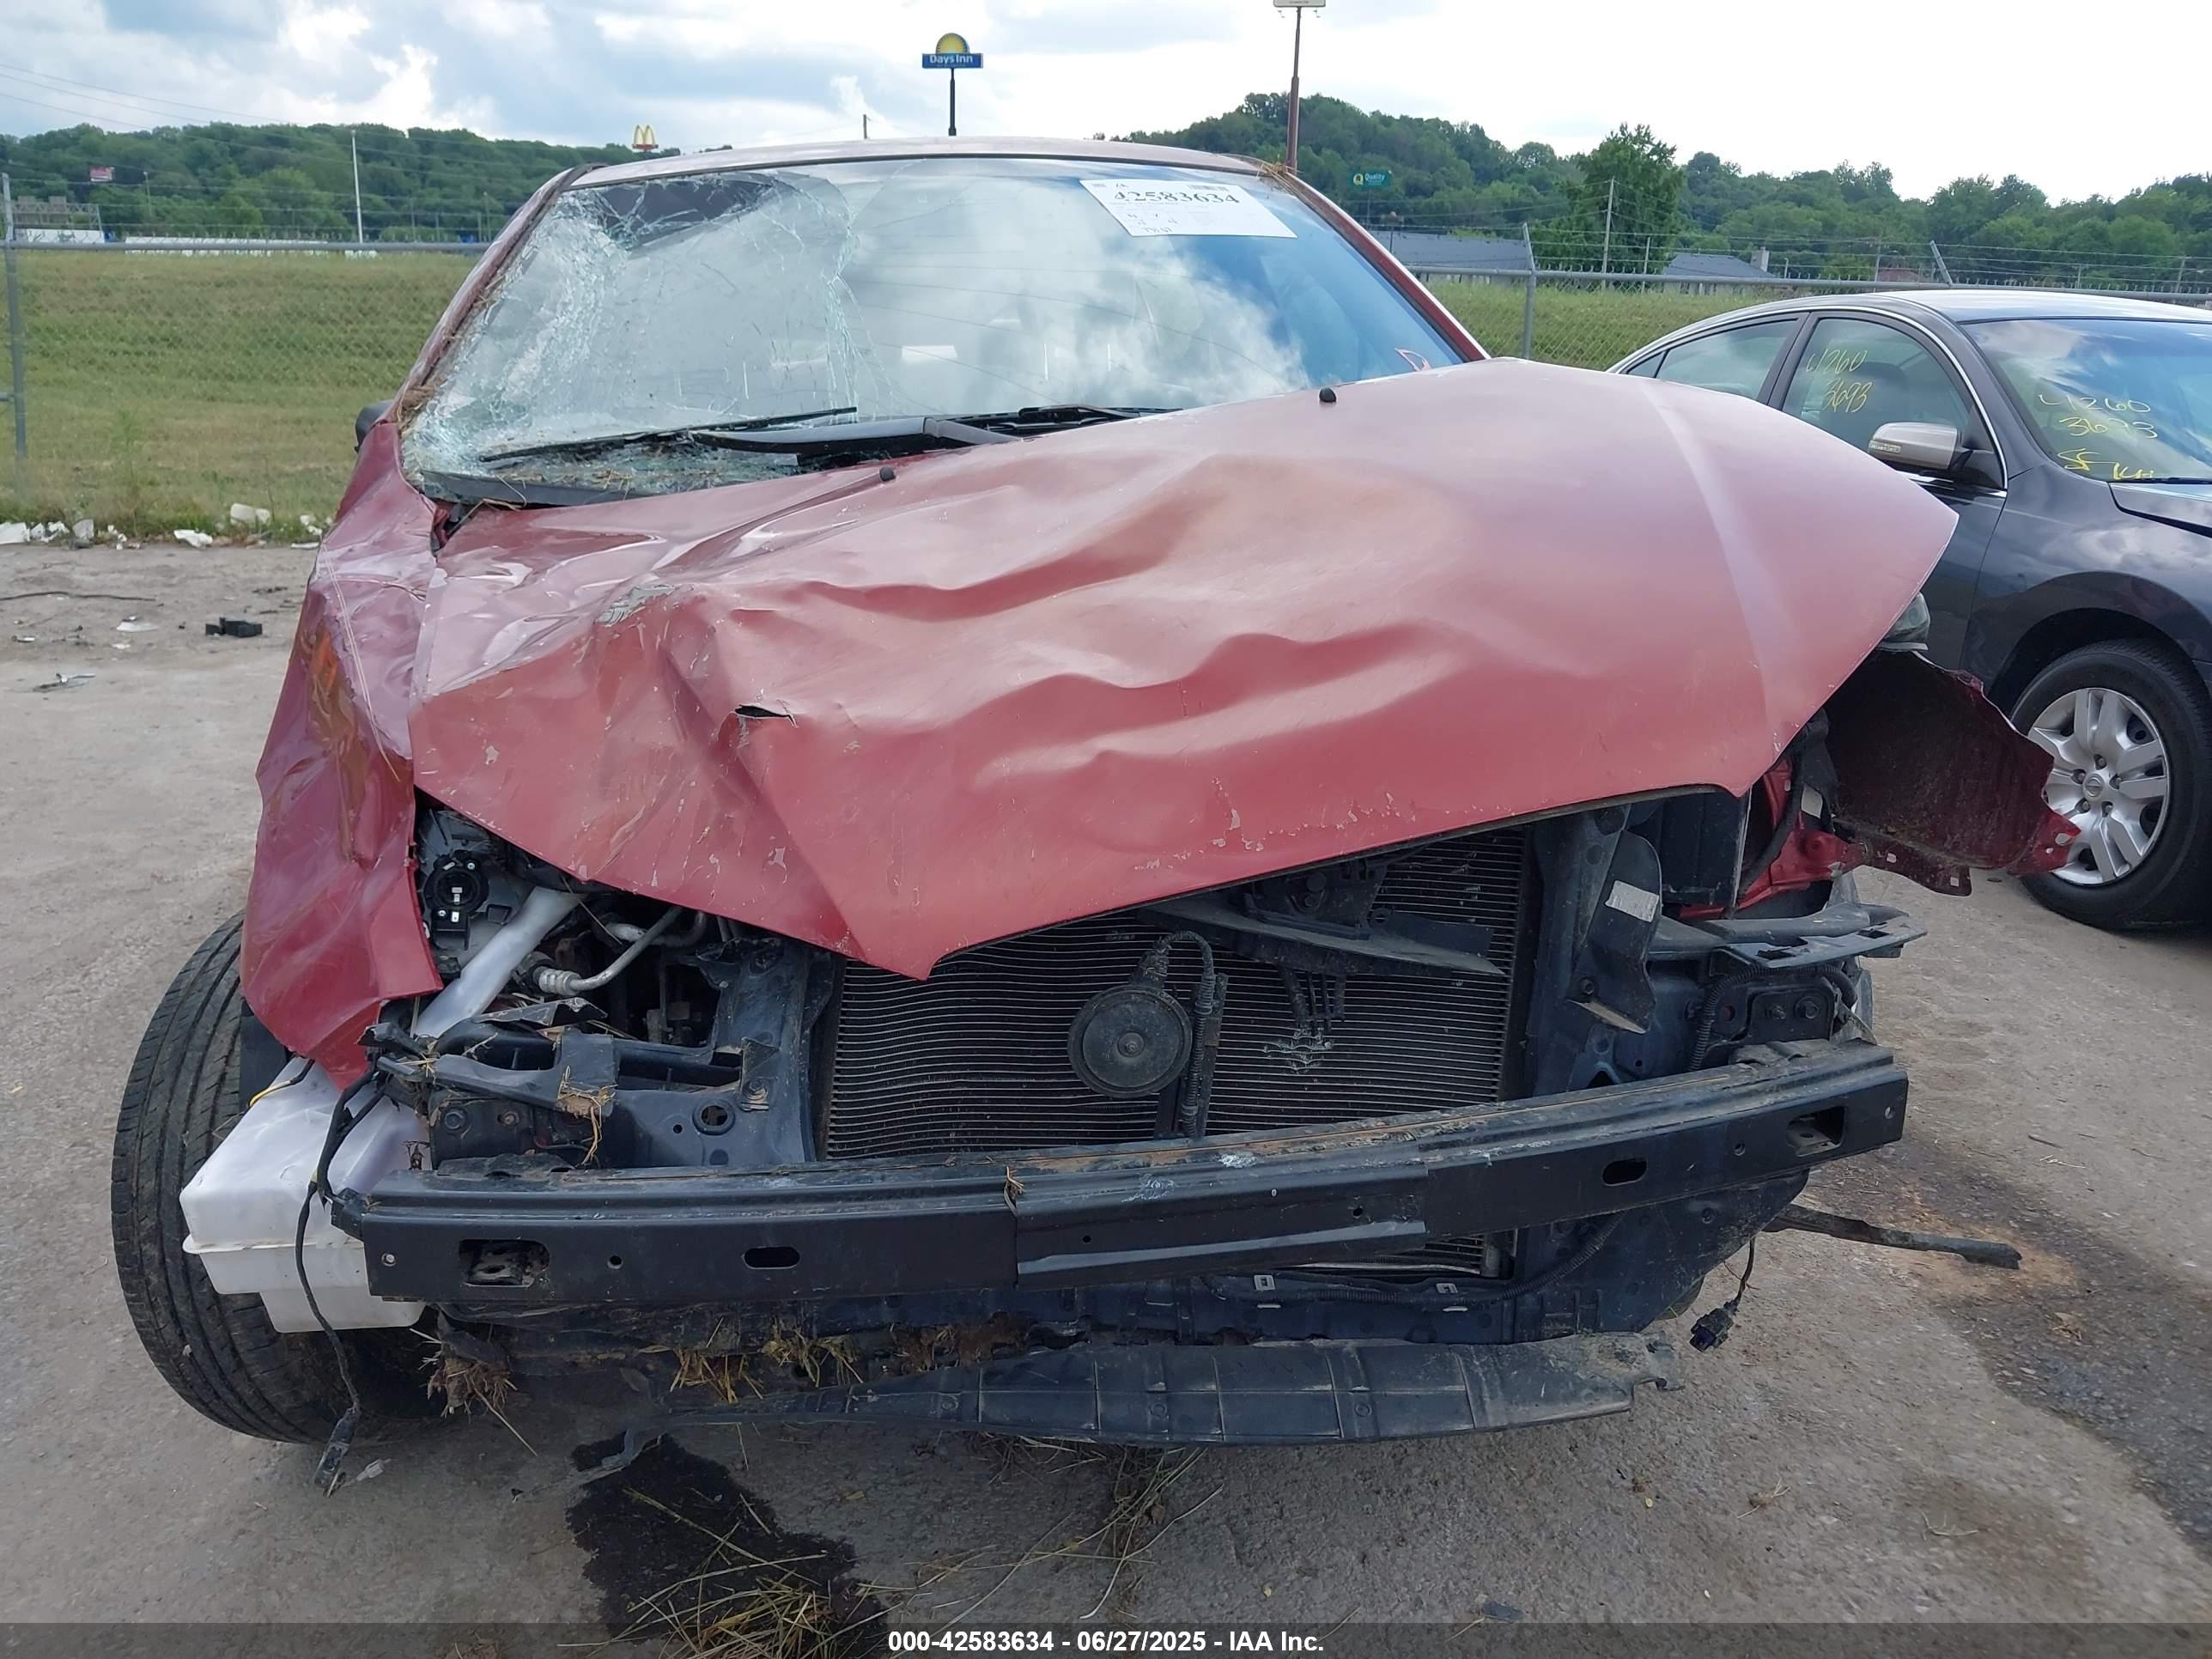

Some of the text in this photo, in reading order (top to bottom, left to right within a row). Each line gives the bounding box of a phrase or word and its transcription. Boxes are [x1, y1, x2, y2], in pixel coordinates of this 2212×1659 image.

[929, 54, 973, 64] Days Inn
[1115, 191, 1240, 204] 42583634
